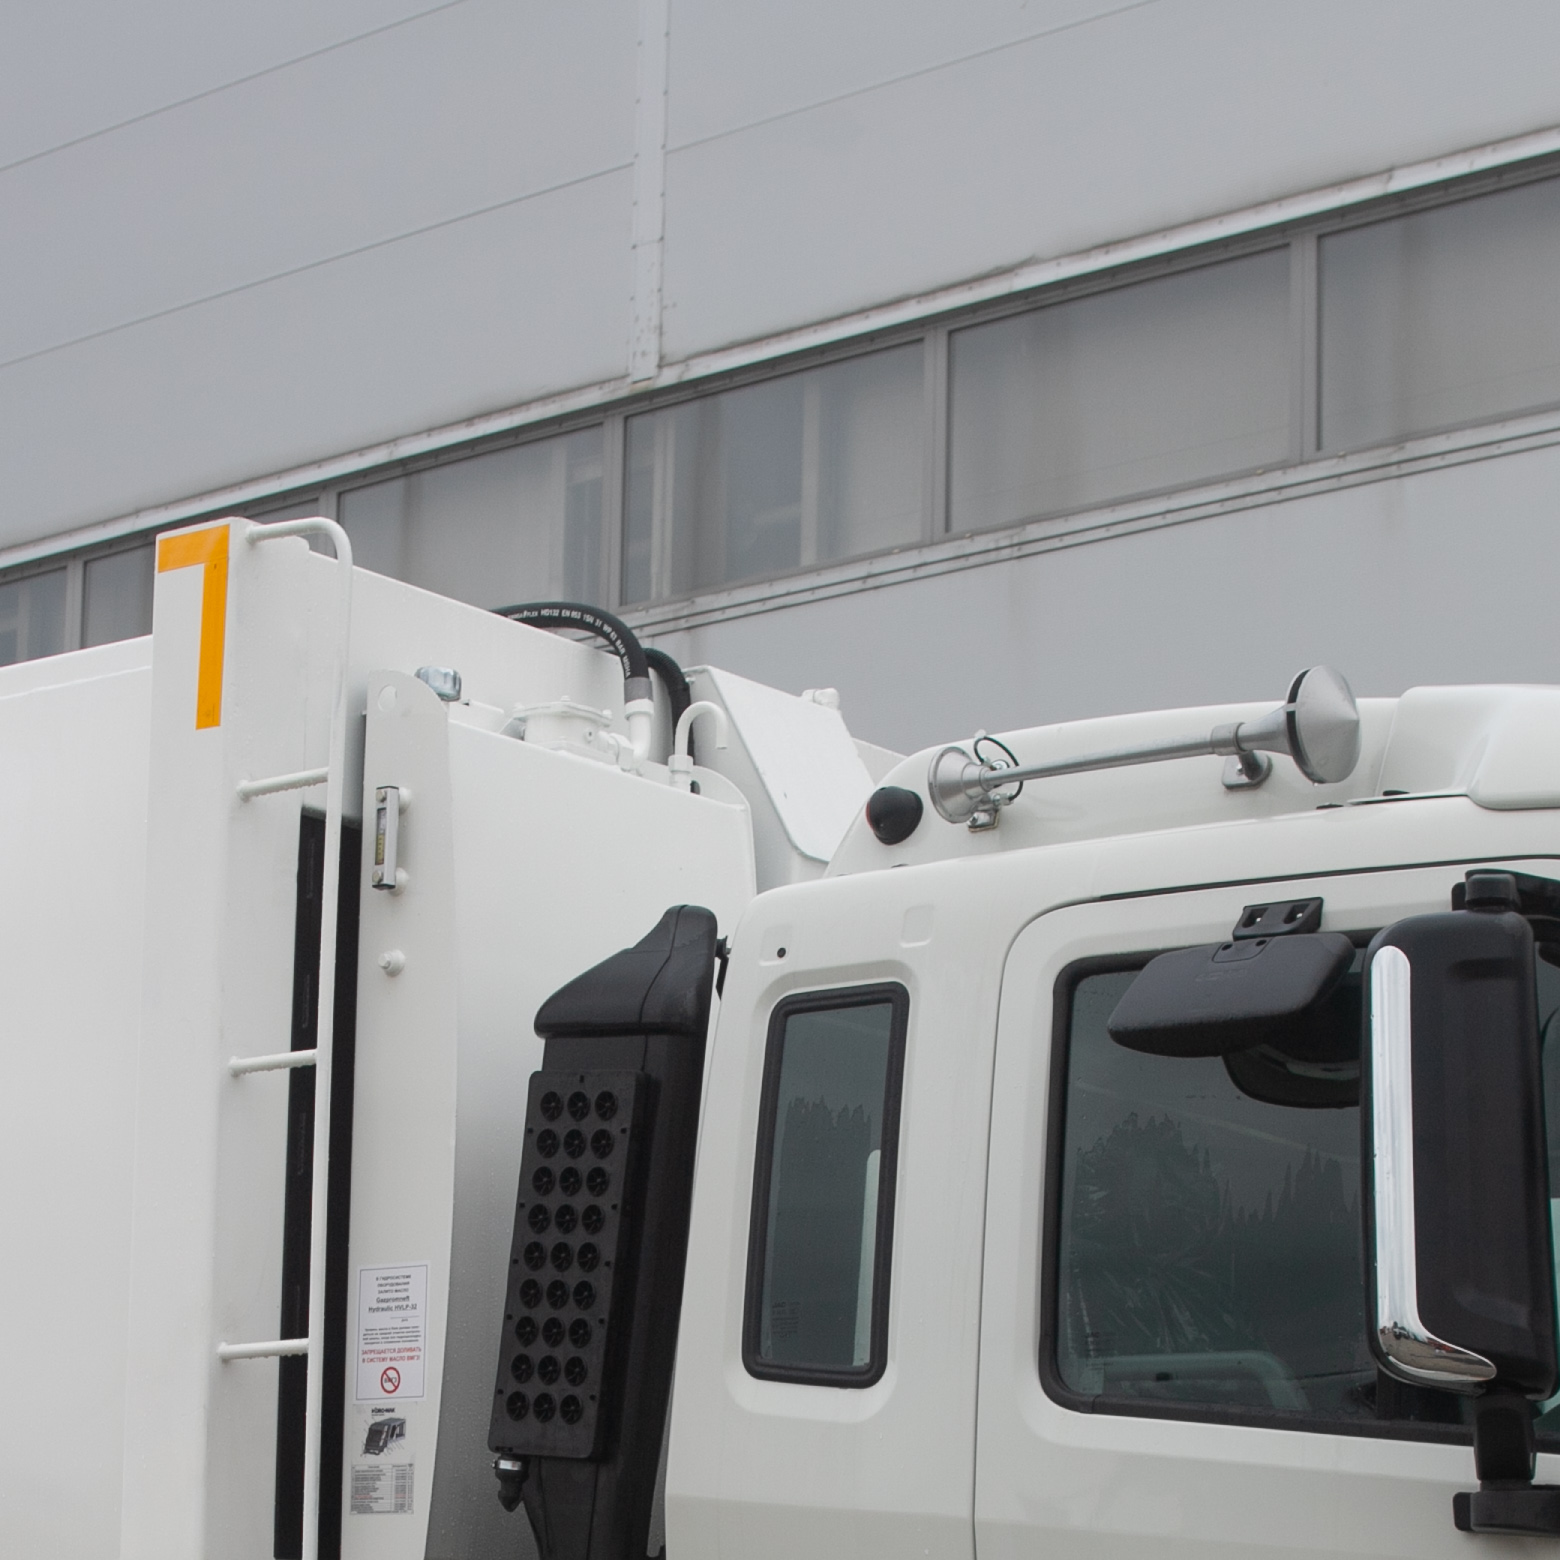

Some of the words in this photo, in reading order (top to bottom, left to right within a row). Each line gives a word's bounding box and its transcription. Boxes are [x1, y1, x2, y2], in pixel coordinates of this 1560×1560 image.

[561, 608, 571, 618] EN
[602, 623, 613, 634] WP
[615, 639, 626, 655] BAR
[376, 1295, 410, 1304] Gazpromneft
[368, 1305, 394, 1313] Hydraulic
[394, 1303, 418, 1311] HVLP-32
[361, 1347, 396, 1356] ЗАПРЕЩАЕТСЯ
[396, 1346, 422, 1355] ДОЛИВАТЬ
